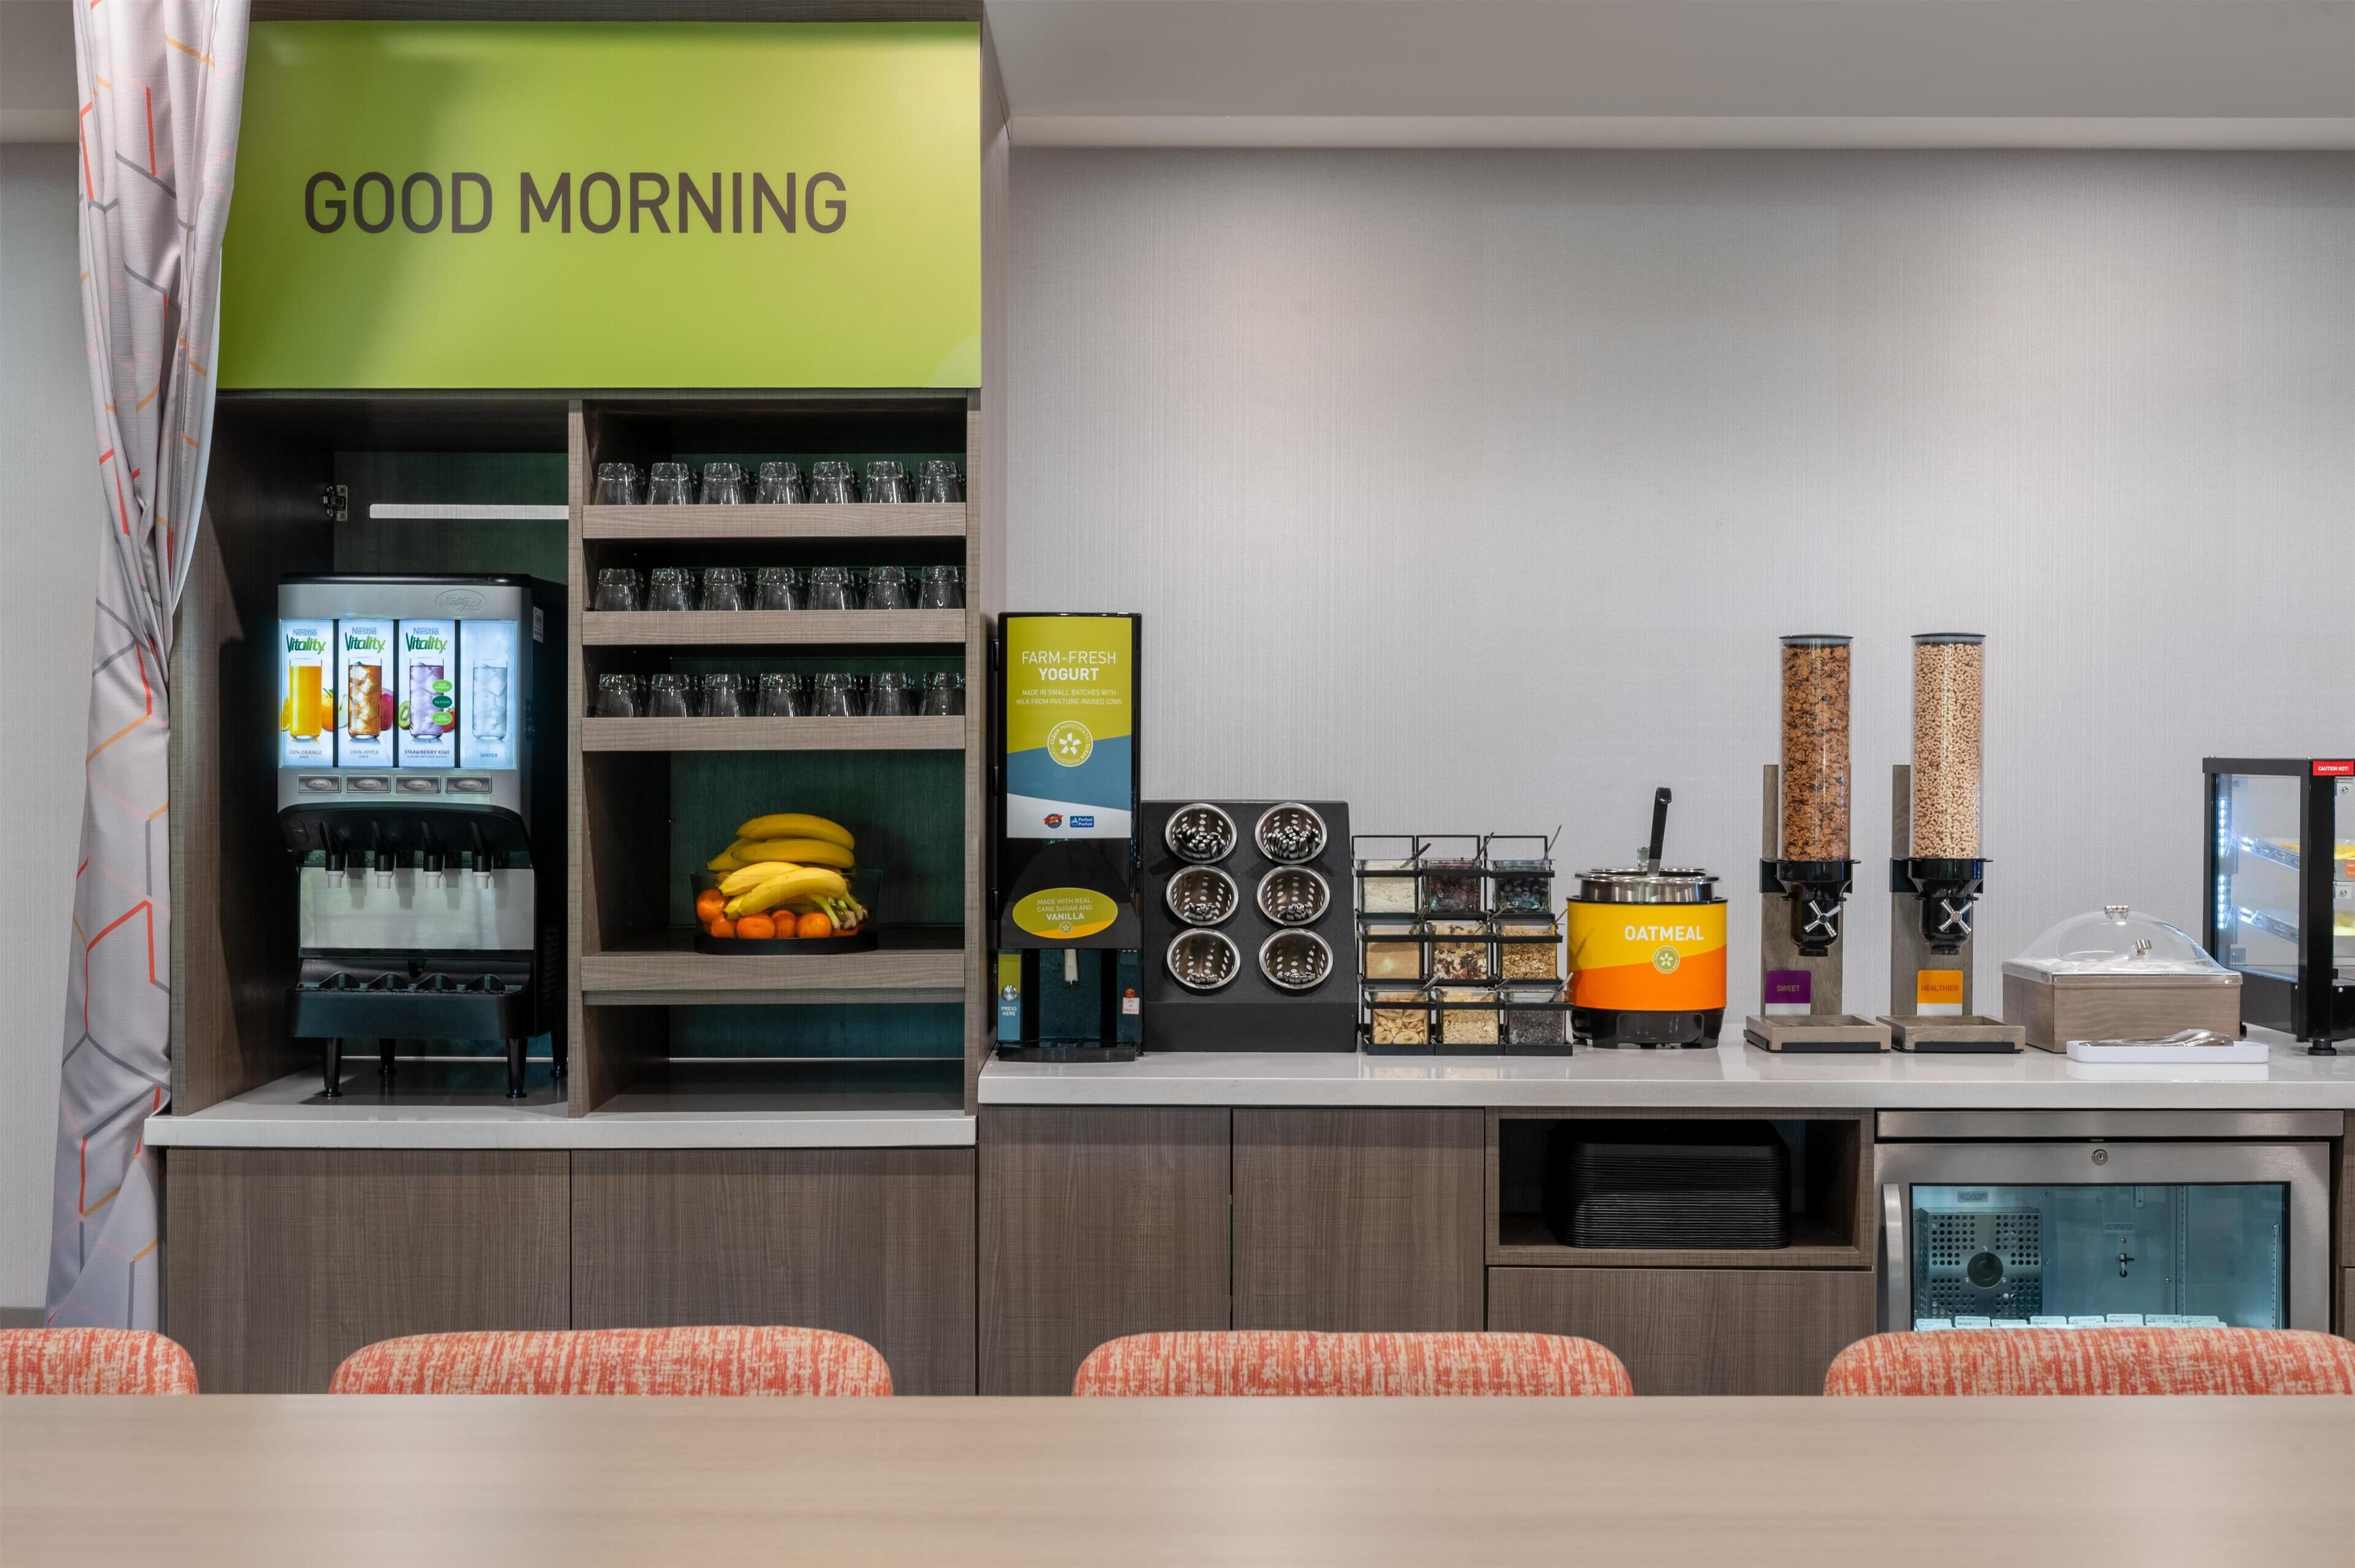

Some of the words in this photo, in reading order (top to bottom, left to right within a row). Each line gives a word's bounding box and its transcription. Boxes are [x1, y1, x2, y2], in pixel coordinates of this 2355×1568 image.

[304, 171, 492, 234] GOOD
[521, 171, 848, 234] MORNING
[286, 633, 327, 655] Vitality
[345, 632, 386, 654] Vitality
[405, 632, 448, 654] Vitality
[1022, 651, 1116, 664] FARM-FRESH
[1039, 668, 1099, 681] YOGURT
[1050, 728, 1060, 745] CLEAN
[1079, 743, 1090, 760] CLEAN
[1624, 925, 1704, 941] OATMEAL
